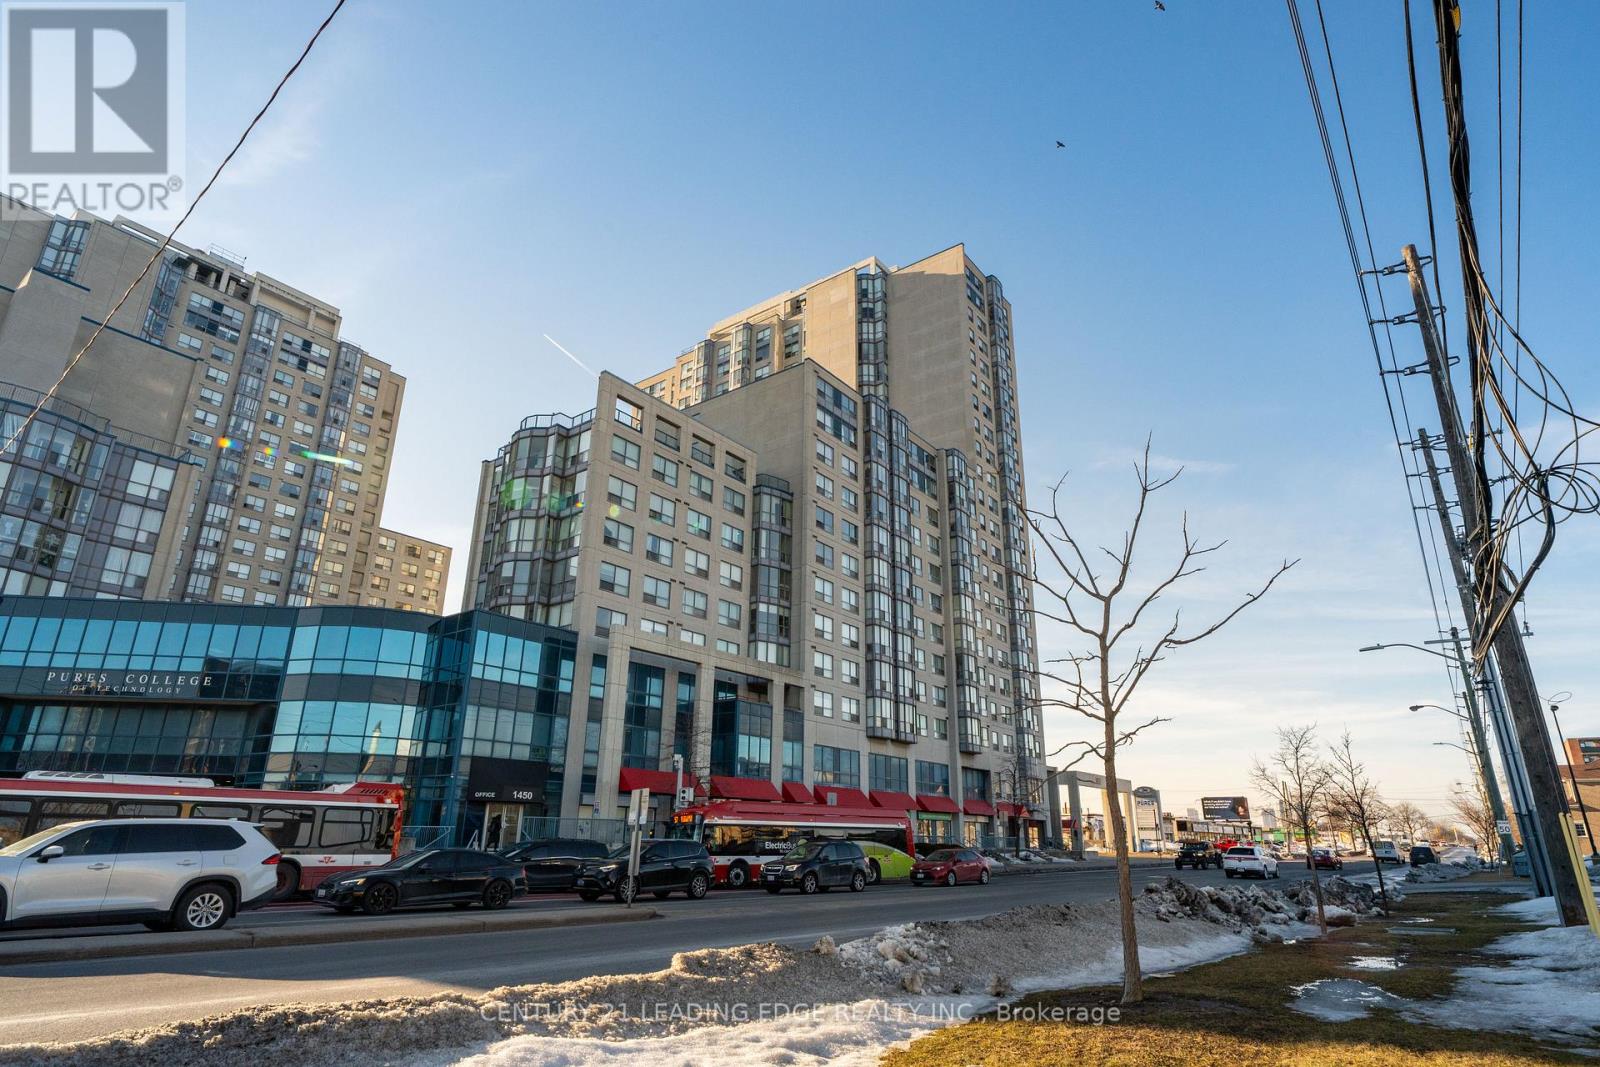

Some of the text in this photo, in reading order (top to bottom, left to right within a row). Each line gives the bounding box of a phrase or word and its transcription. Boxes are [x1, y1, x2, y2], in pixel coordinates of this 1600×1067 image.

[47, 671, 213, 687] PURES COLLEGE
[96, 685, 181, 695] TECHNOLOGY
[512, 790, 534, 800] 1450
